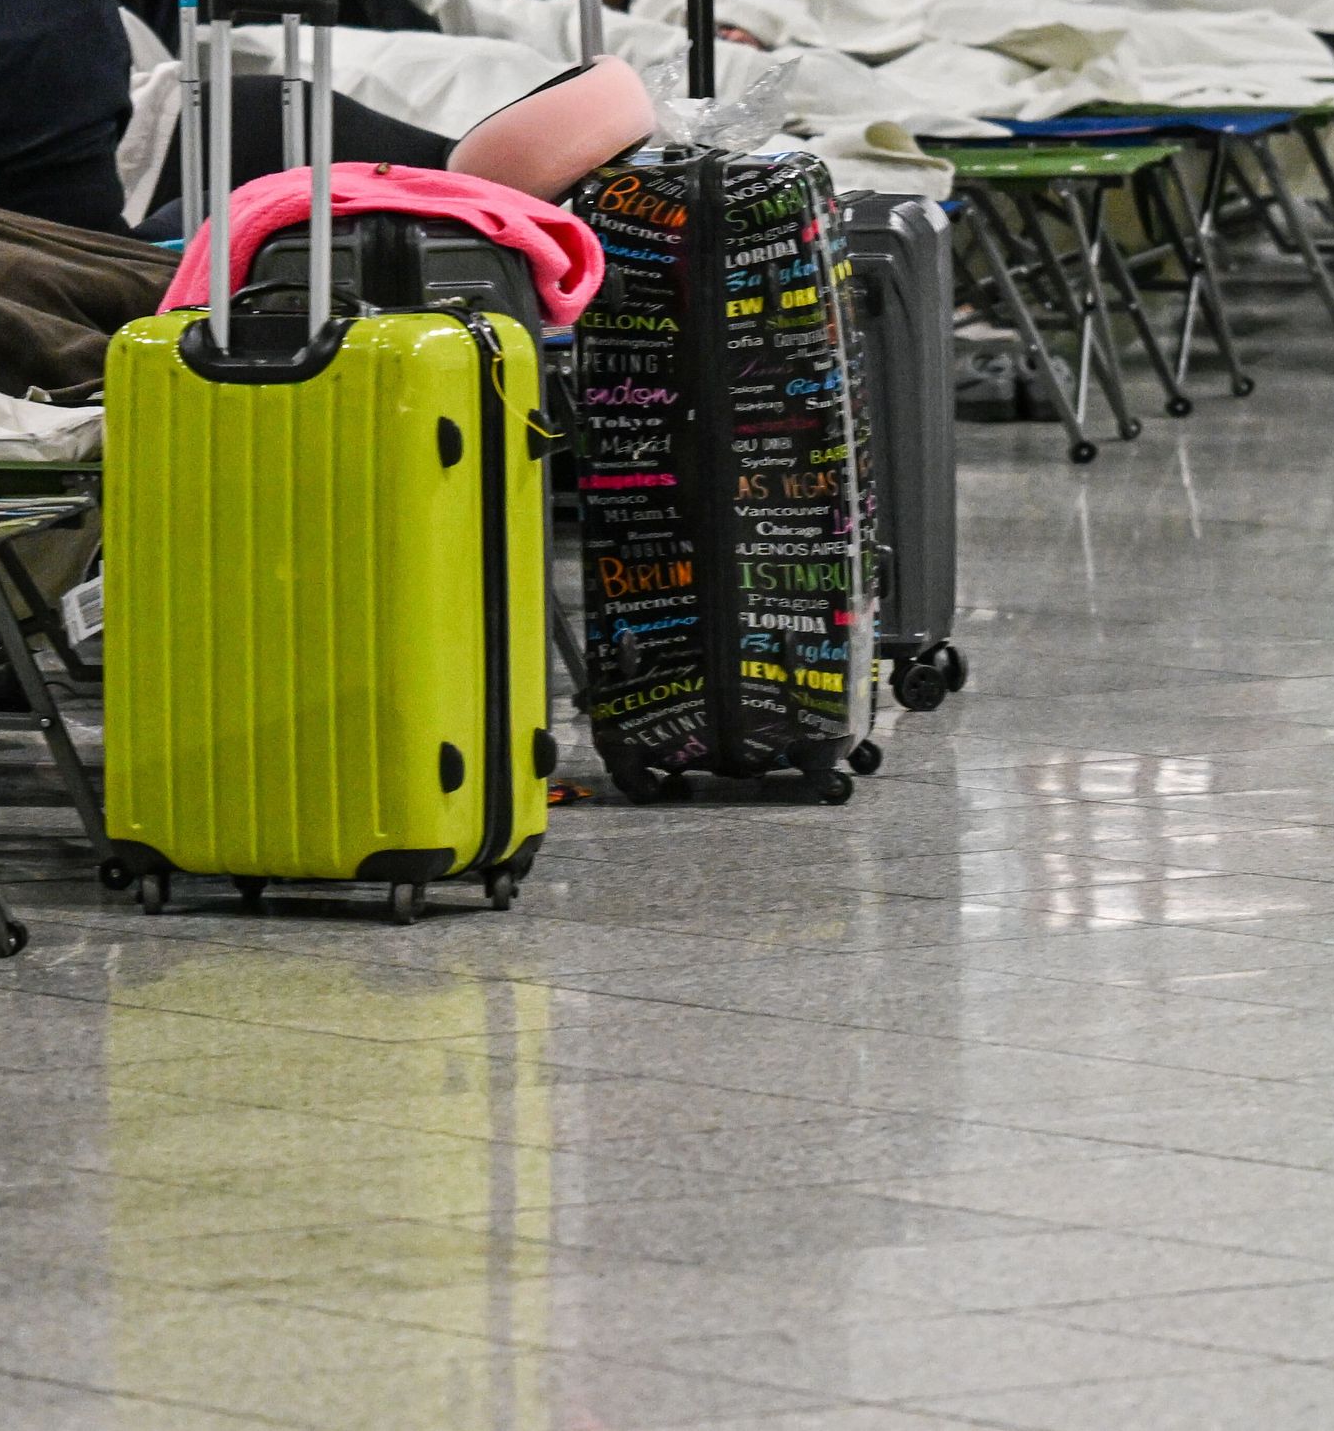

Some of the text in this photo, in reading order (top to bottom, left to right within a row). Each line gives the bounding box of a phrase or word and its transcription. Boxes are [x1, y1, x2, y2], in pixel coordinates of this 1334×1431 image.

[590, 212, 682, 244] Florence
[781, 286, 818, 309] ORK
[588, 416, 663, 431] Tokyo
[740, 456, 798, 468] Sydney
[733, 506, 831, 516] Vancouver
[756, 521, 823, 537] Chicago
[604, 595, 697, 615] Florence
[748, 593, 829, 611] Prague
[794, 668, 844, 692] YORK
